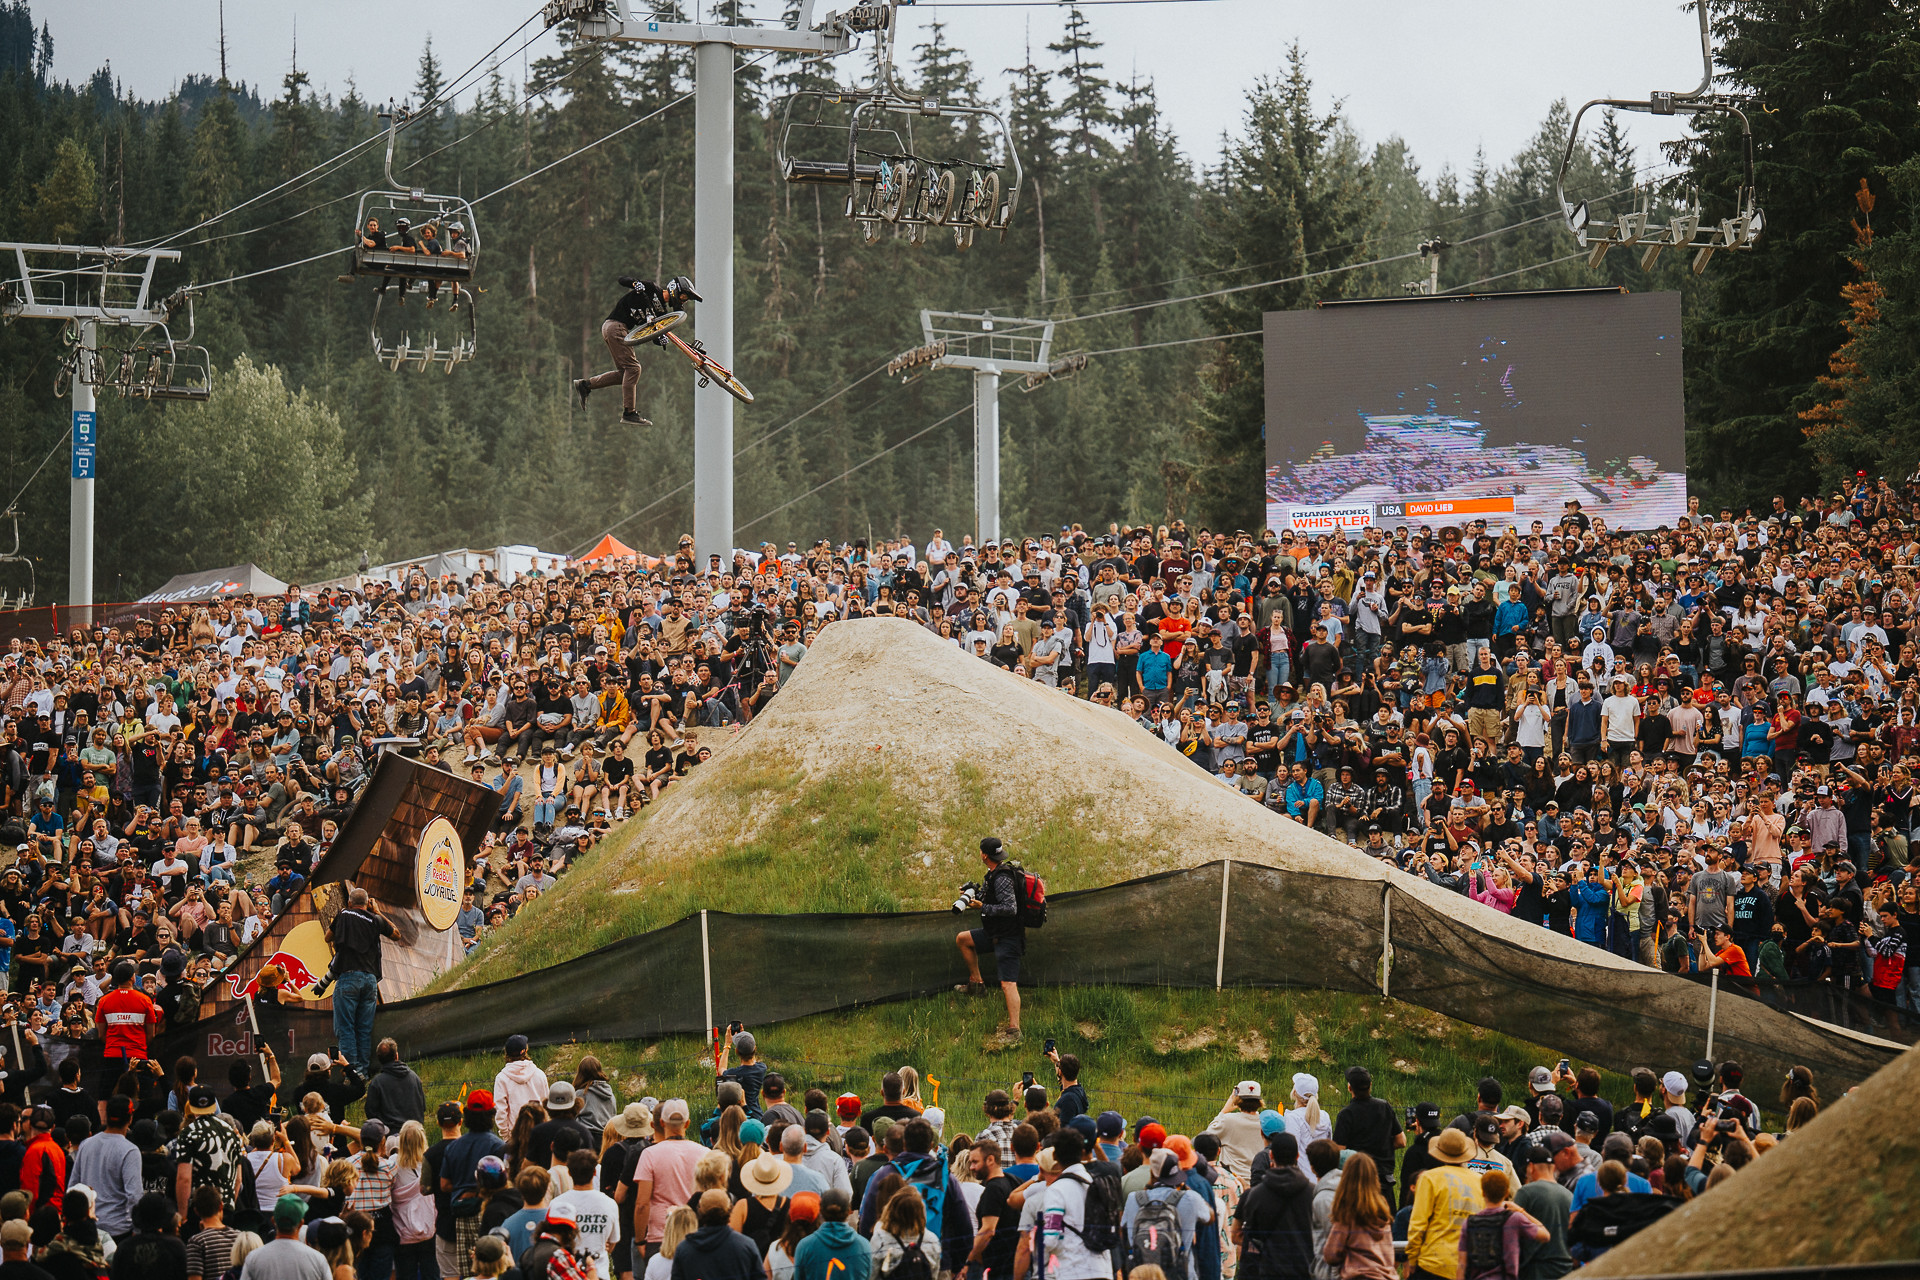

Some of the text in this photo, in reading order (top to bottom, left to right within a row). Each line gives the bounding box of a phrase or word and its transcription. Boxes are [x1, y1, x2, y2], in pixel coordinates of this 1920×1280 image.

[1292, 508, 1369, 518] CRANKWORX
[1381, 503, 1453, 516] USA DAVID LIEB
[1293, 515, 1370, 528] WHISTLER
[432, 867, 453, 883] Red Bull
[424, 883, 457, 902] JOYRIDE
[1734, 910, 1753, 919] RAKEN
[208, 1031, 250, 1056] Red
[576, 1214, 608, 1223] ORTS
[581, 1224, 606, 1233] ORY
